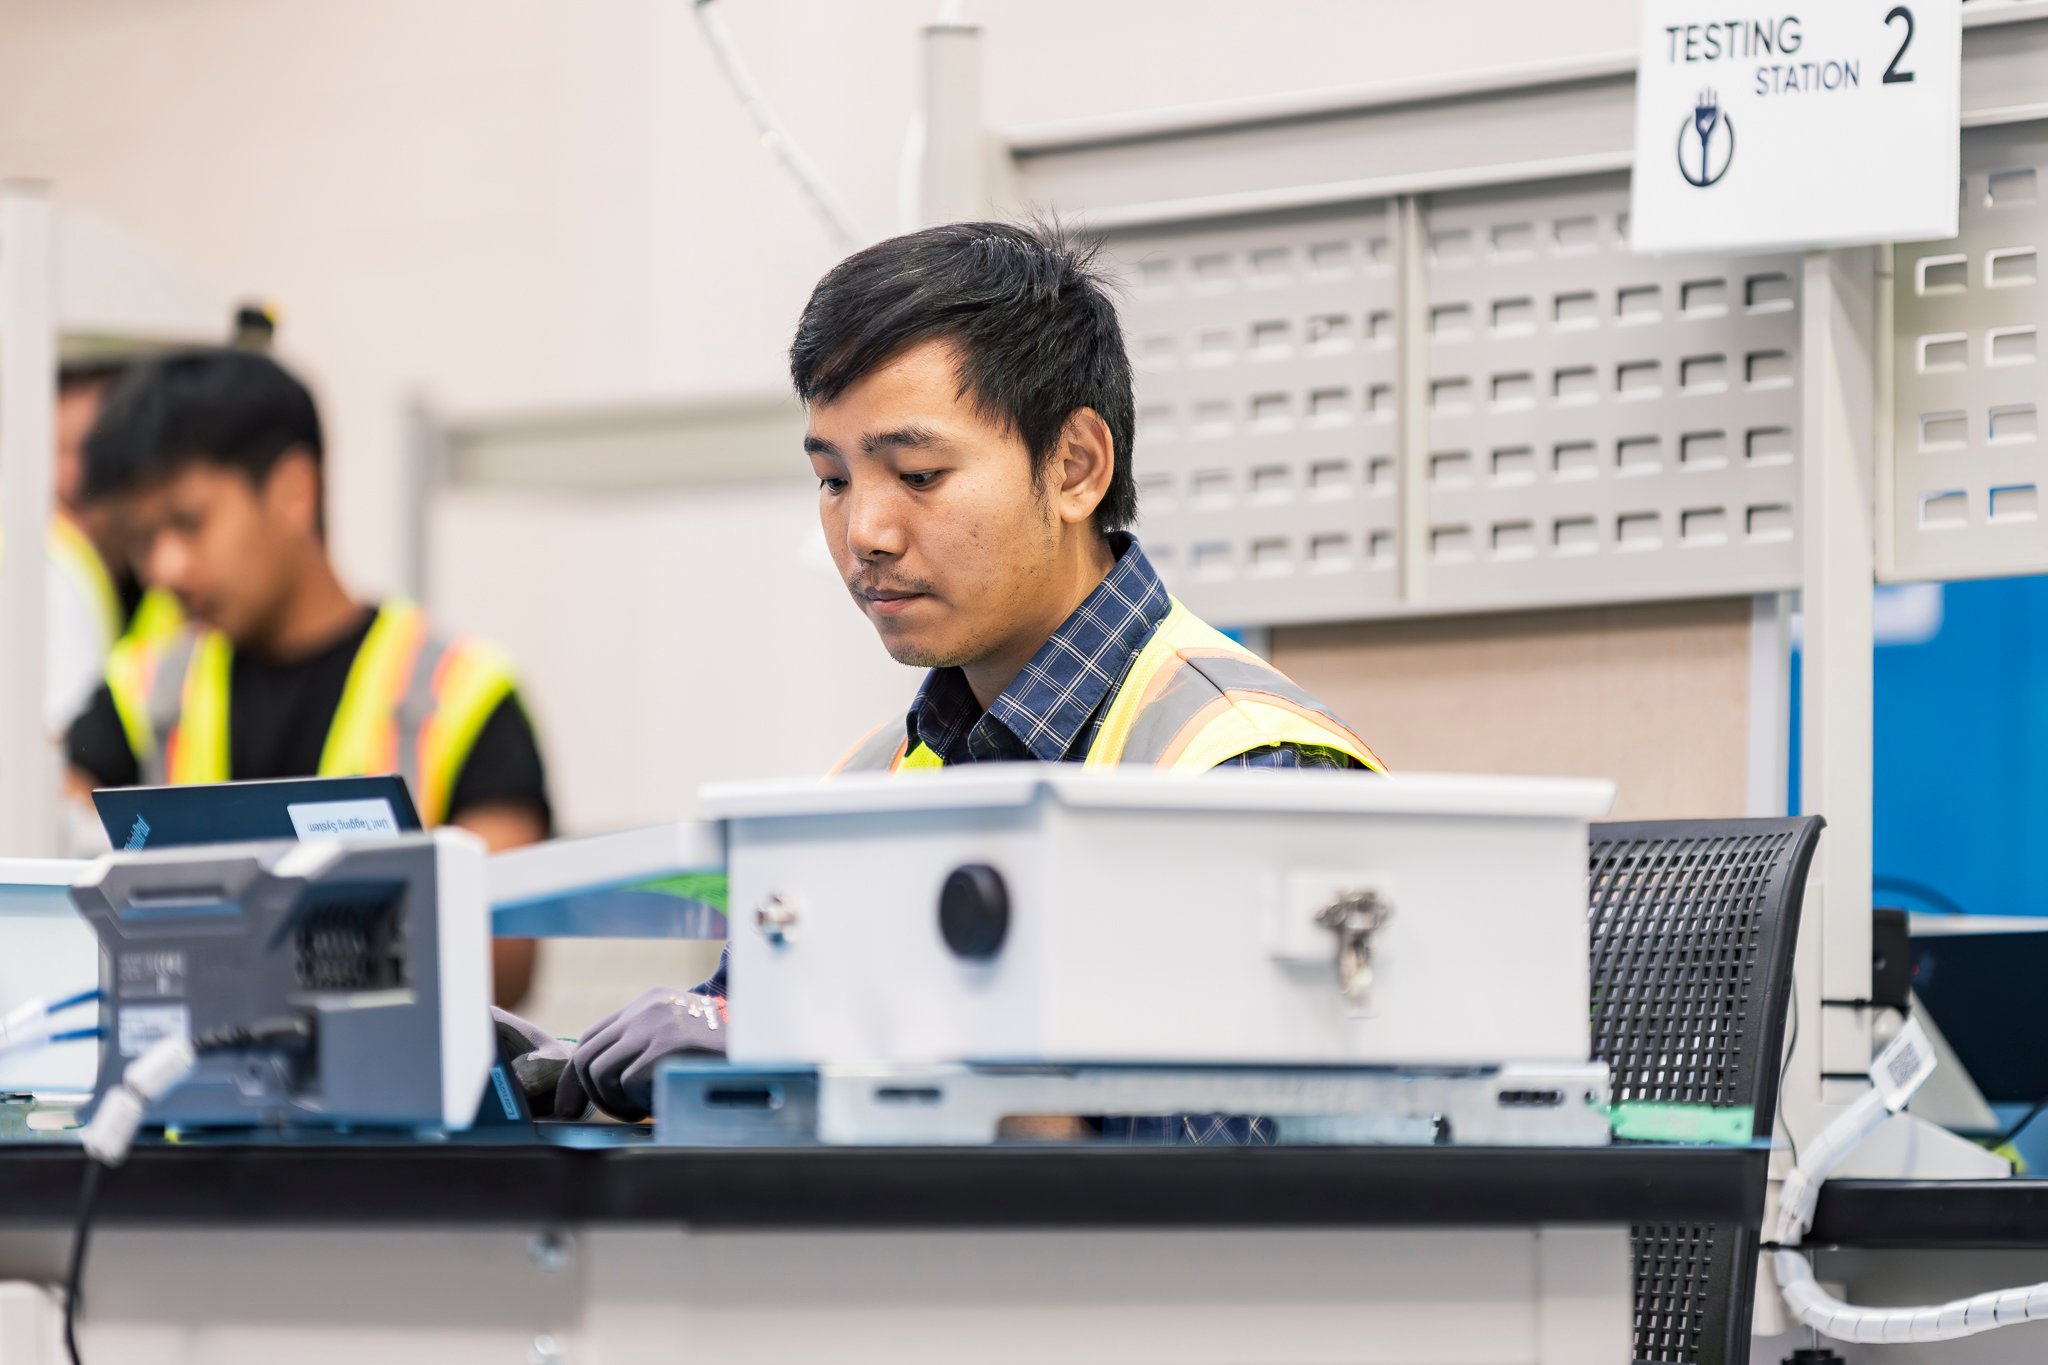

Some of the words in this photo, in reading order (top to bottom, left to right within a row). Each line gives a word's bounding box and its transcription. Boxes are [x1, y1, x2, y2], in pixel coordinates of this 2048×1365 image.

[1666, 16, 1802, 62] TESTING
[1882, 6, 1915, 84] 2
[1756, 60, 1860, 96] STATION
[307, 820, 338, 833] System
[337, 818, 371, 831] Tagging
[371, 818, 390, 830] Unit
[494, 1071, 516, 1116] Lenovo
